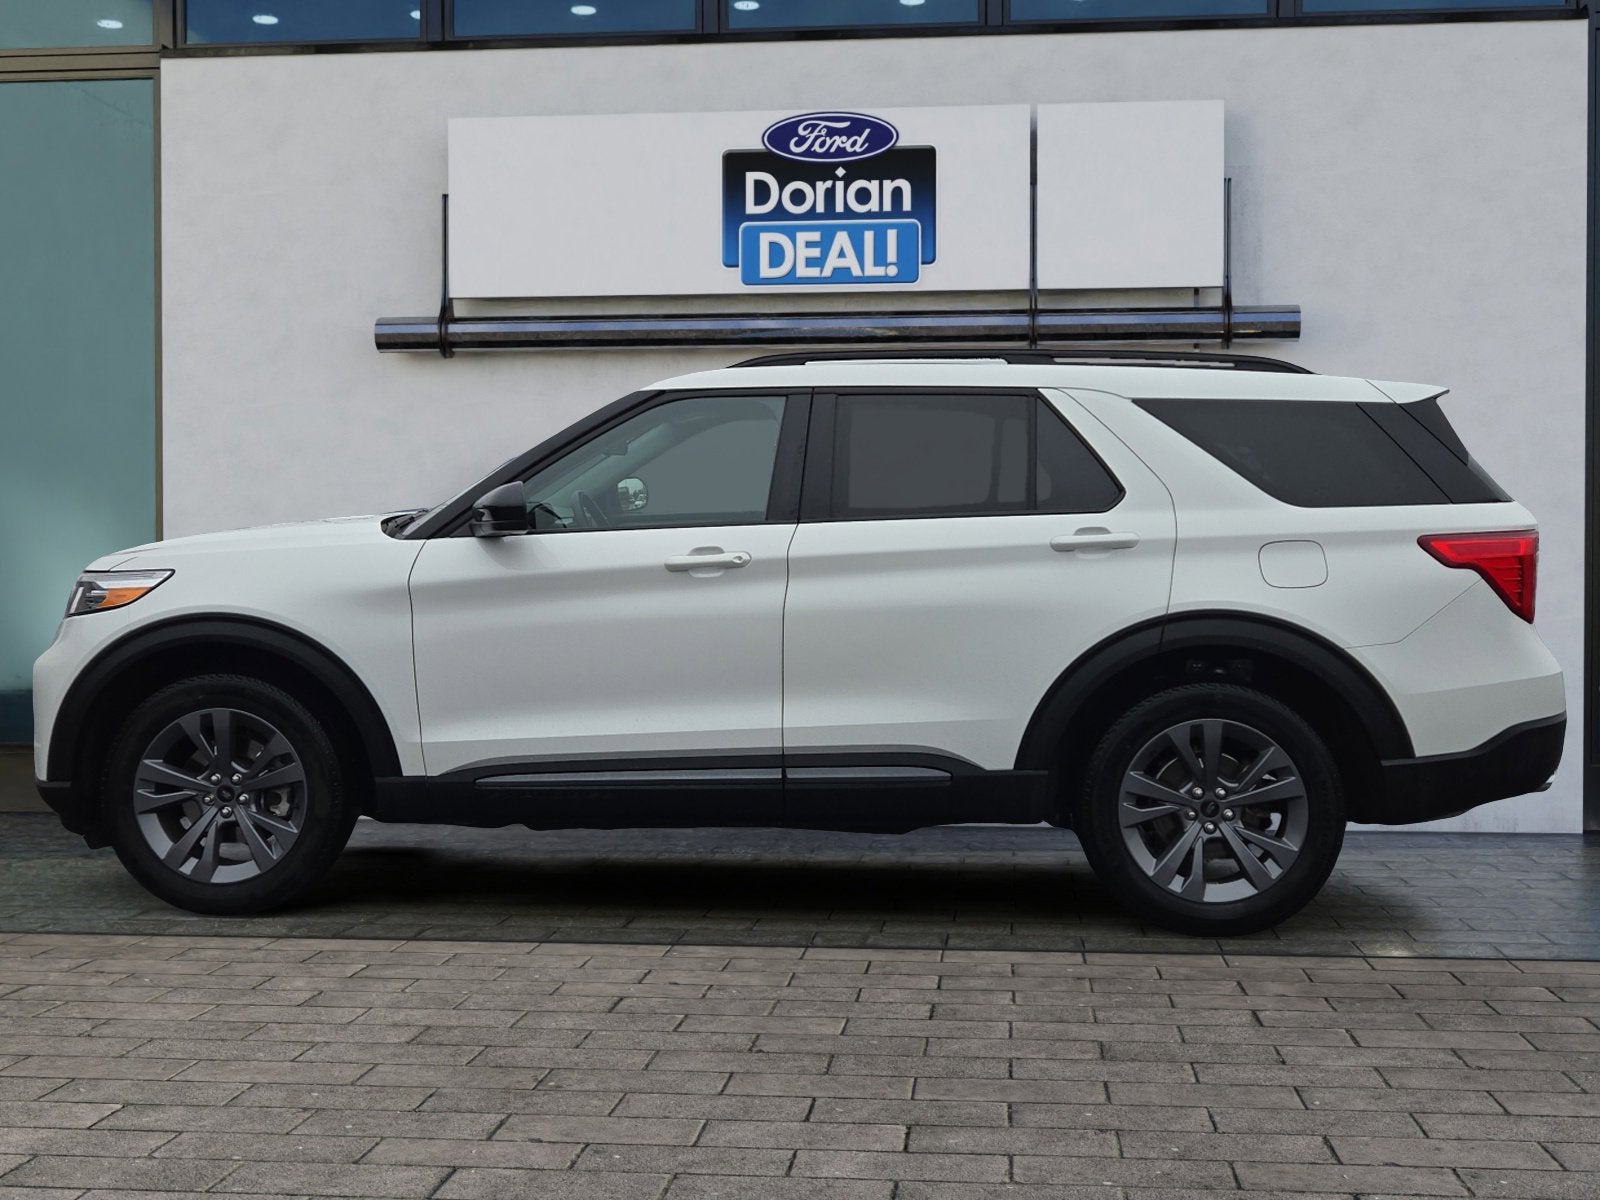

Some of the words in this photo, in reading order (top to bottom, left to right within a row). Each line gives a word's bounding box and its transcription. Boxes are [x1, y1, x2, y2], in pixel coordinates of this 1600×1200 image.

[789, 120, 870, 153] Ford
[745, 166, 912, 214] Dorian
[759, 229, 899, 279] DEAL!
